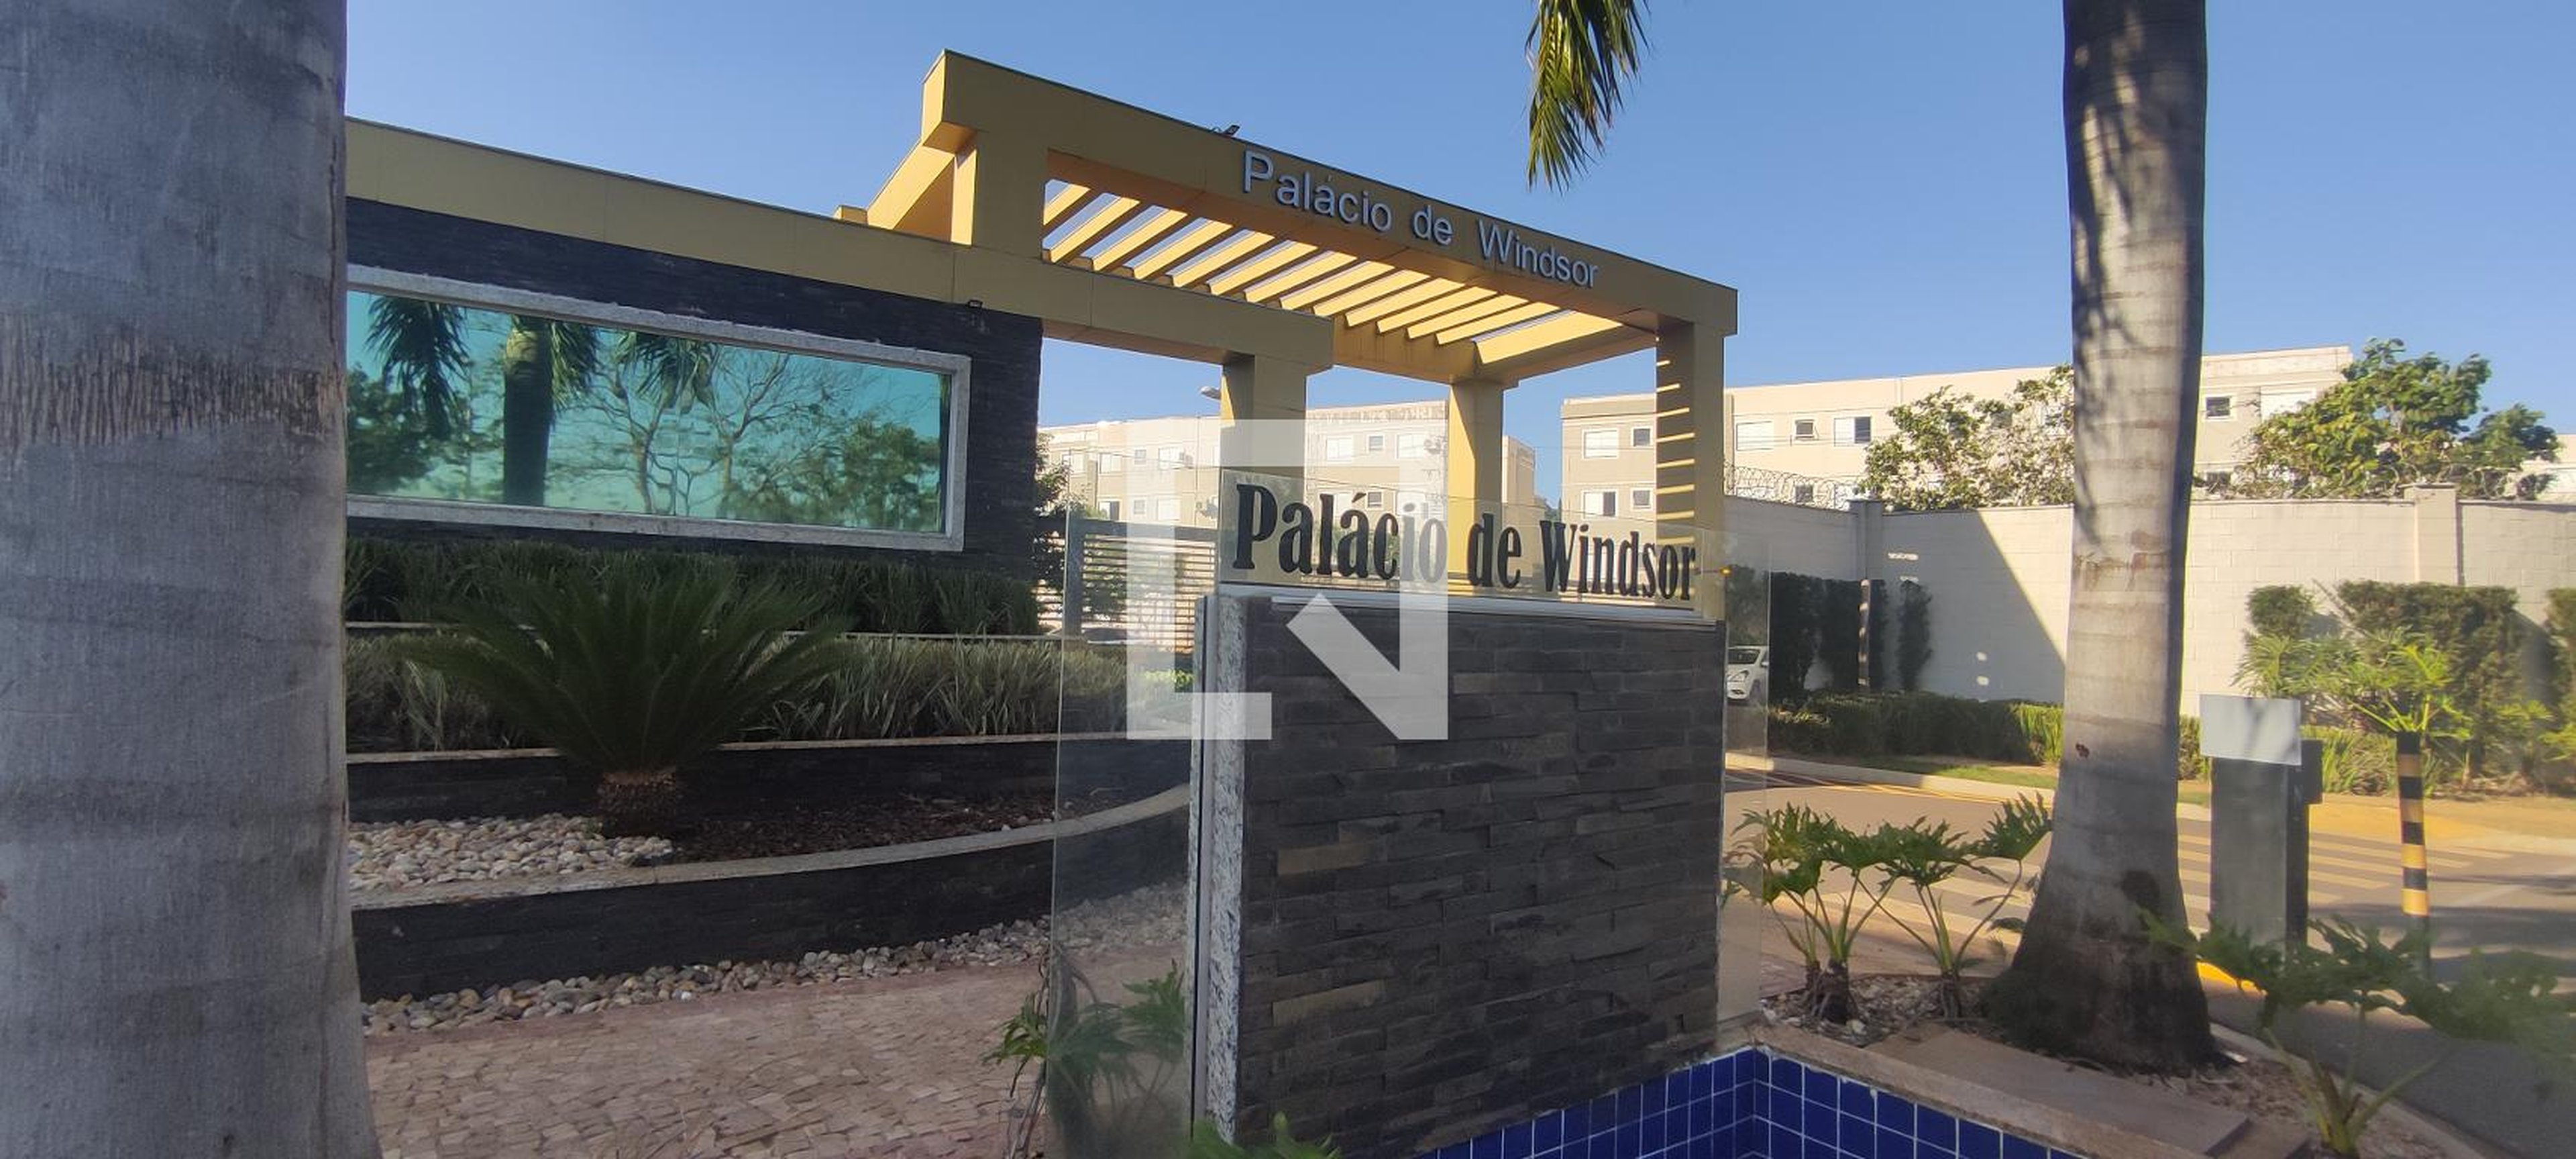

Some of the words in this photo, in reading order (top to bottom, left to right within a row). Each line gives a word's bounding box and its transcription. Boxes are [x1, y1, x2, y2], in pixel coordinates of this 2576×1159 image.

[1242, 150, 1393, 232] Palácio
[1412, 205, 1454, 246] de
[1478, 219, 1599, 288] Windsor
[1232, 483, 1447, 583] Palácio
[1467, 513, 1522, 589] de
[1540, 519, 1697, 601] Windsor
